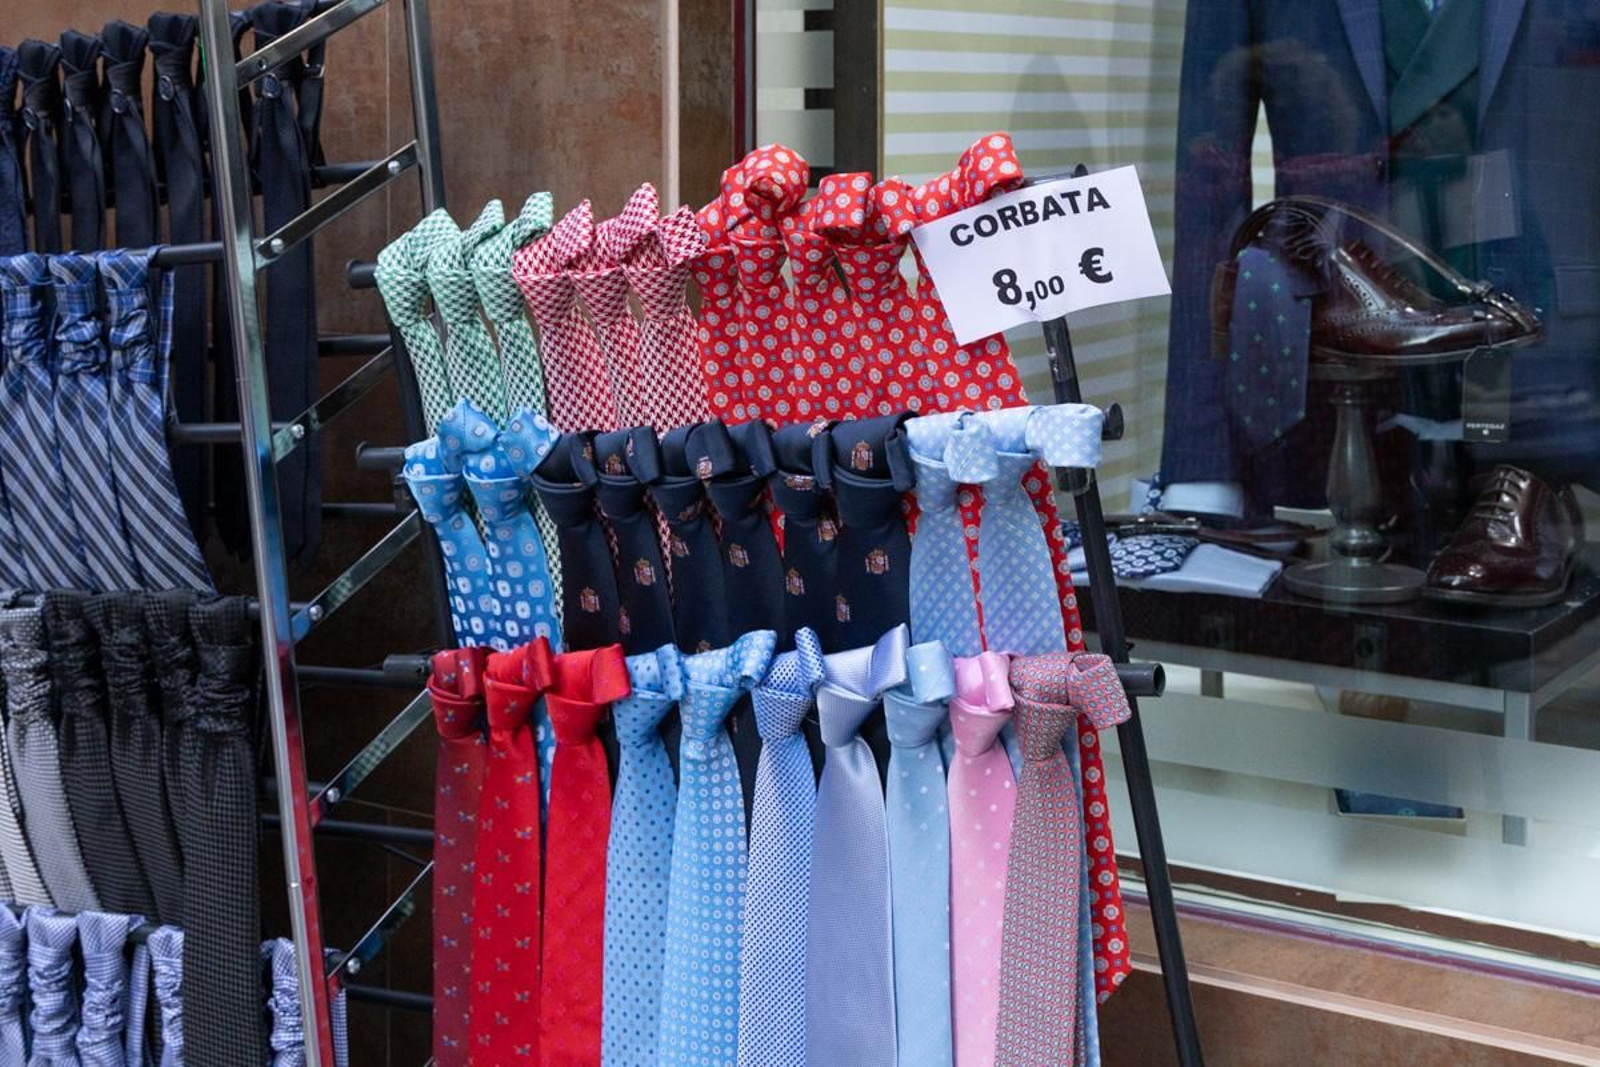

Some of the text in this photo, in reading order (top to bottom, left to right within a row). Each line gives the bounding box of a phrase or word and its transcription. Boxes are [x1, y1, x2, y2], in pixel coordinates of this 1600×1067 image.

[950, 187, 1111, 246] CORBATA
[992, 247, 1114, 311] 8,00 €
